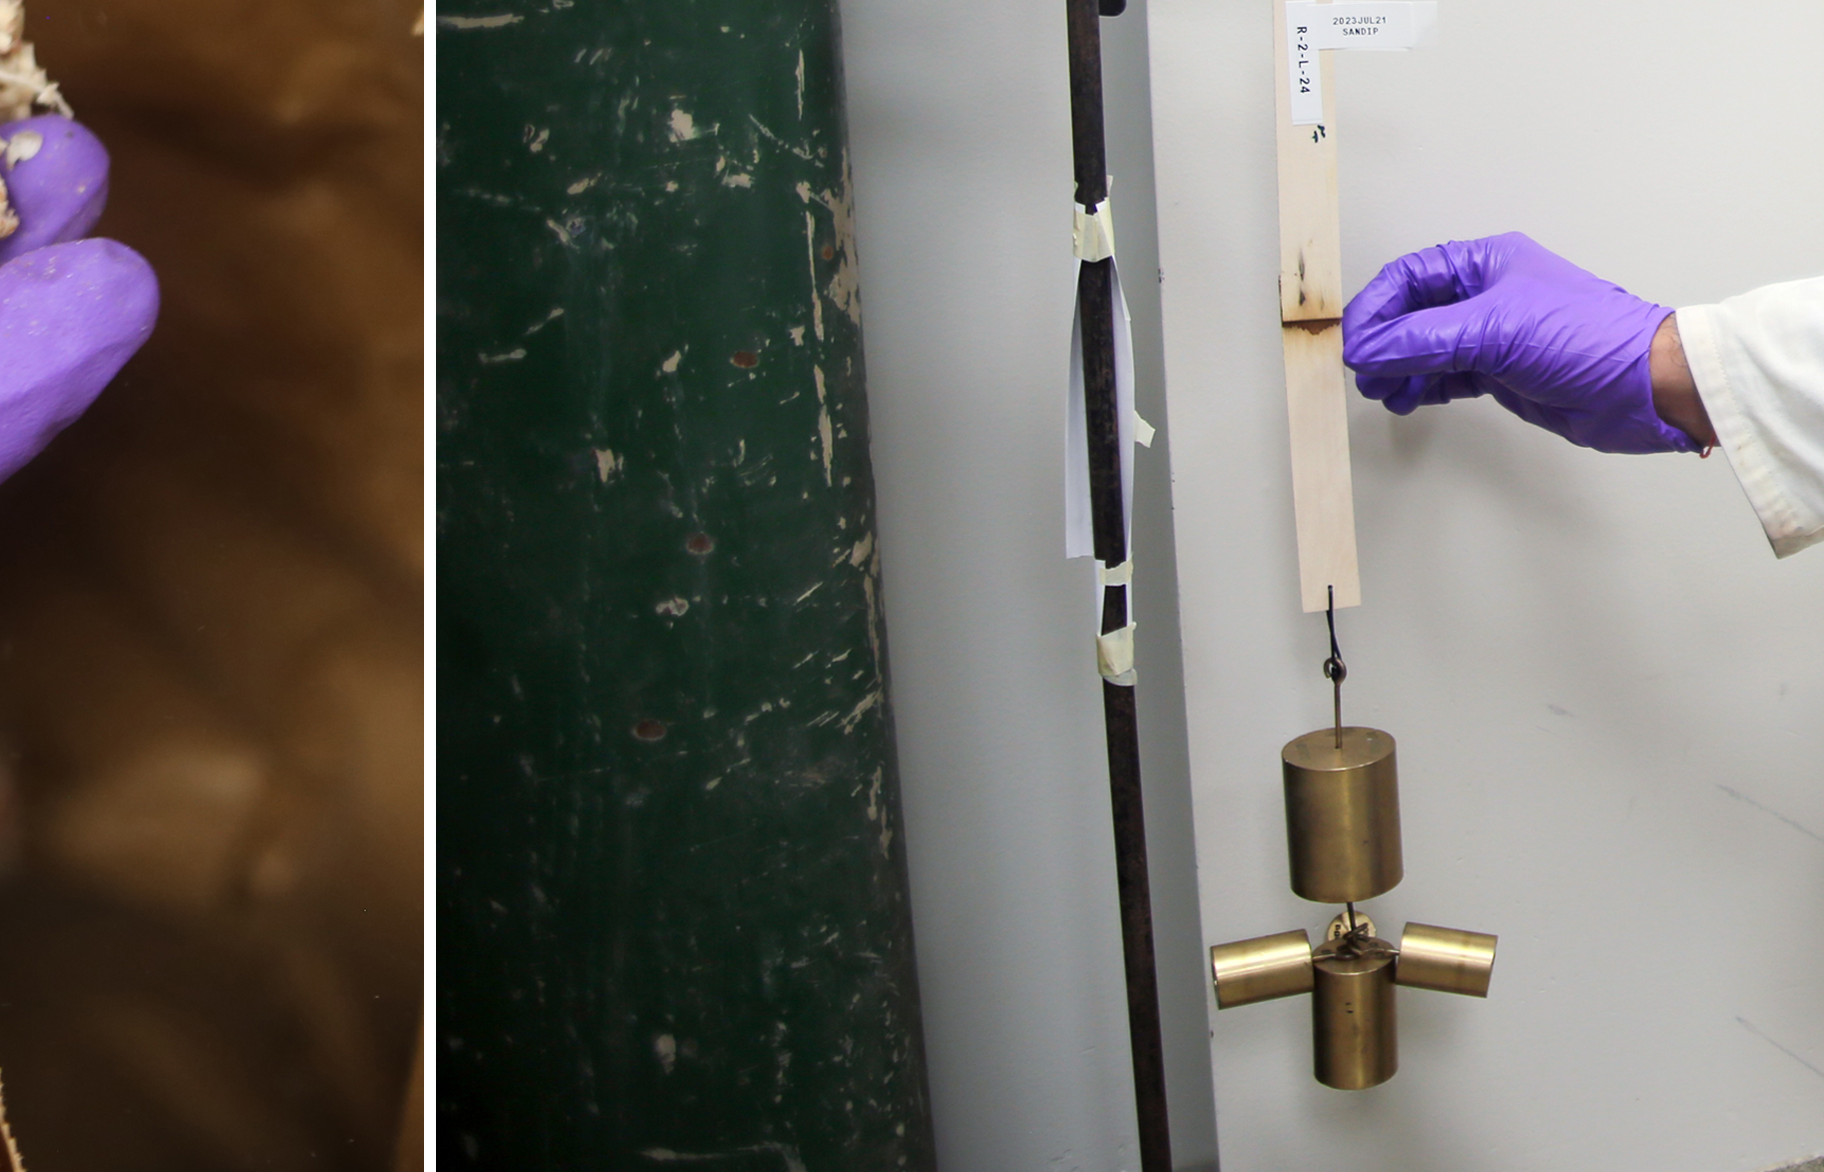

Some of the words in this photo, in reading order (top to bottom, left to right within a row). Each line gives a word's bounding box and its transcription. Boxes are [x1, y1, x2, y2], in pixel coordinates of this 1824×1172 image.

[1333, 16, 1386, 25] 2023JUL21
[1342, 27, 1379, 36] SANDIP
[1297, 26, 1311, 93] R-2-L-24
